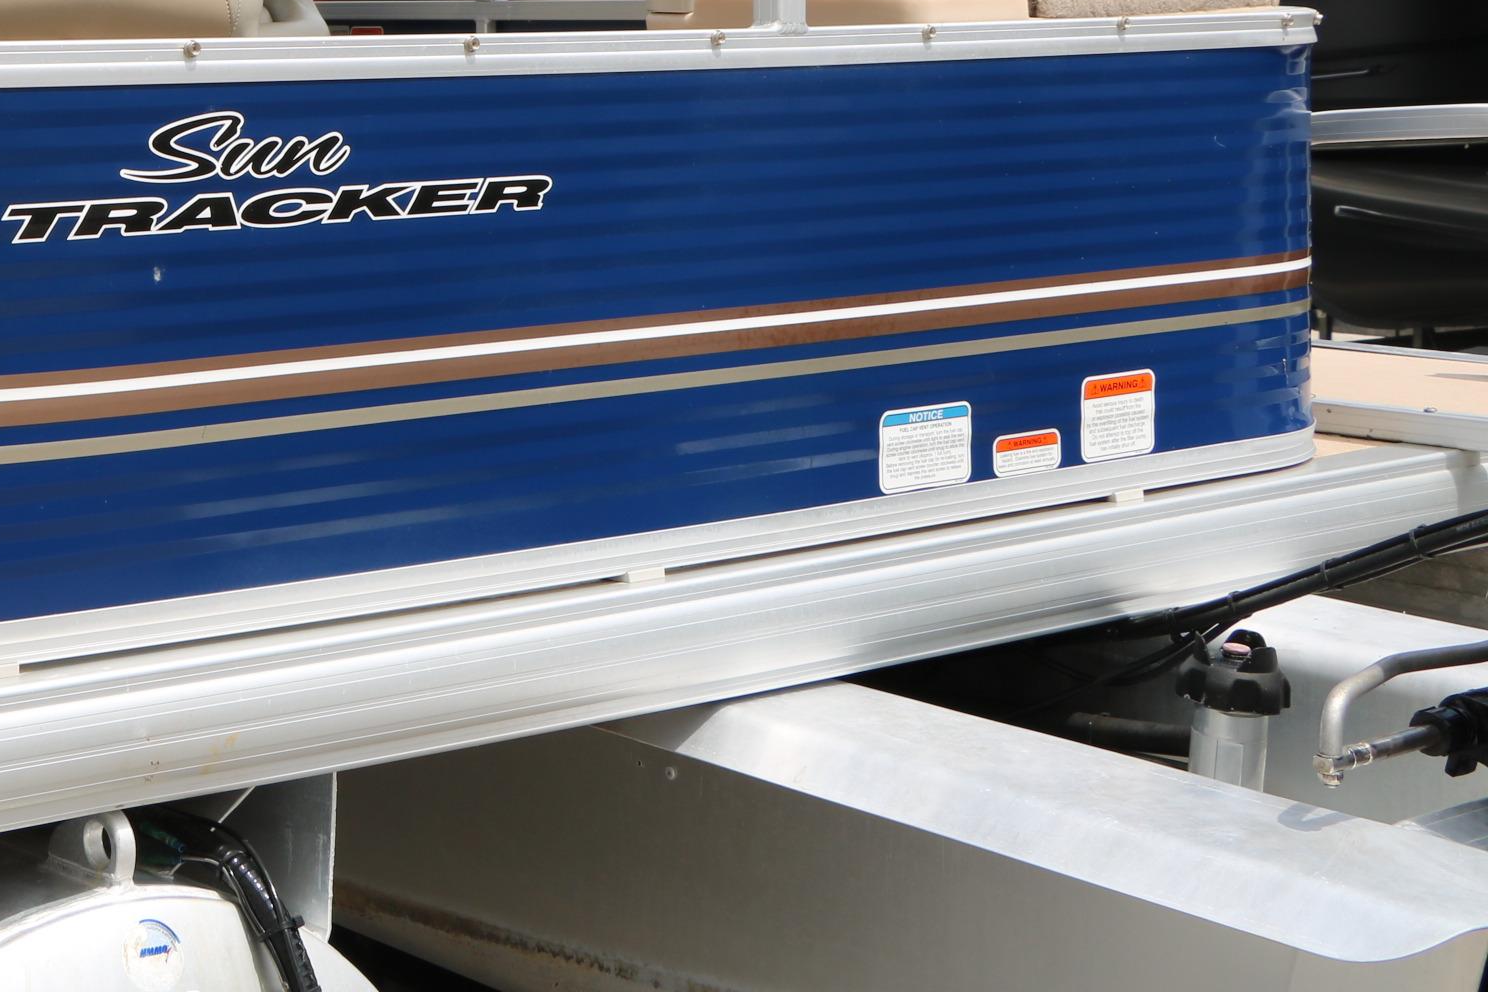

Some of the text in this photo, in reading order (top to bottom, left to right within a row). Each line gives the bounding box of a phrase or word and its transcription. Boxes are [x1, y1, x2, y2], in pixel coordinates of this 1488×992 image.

[120, 110, 350, 183] Sun
[1, 174, 553, 245] TRACKER
[1100, 379, 1138, 392] WARNING
[909, 409, 944, 423] NOTICE
[1013, 437, 1042, 447] WARNING
